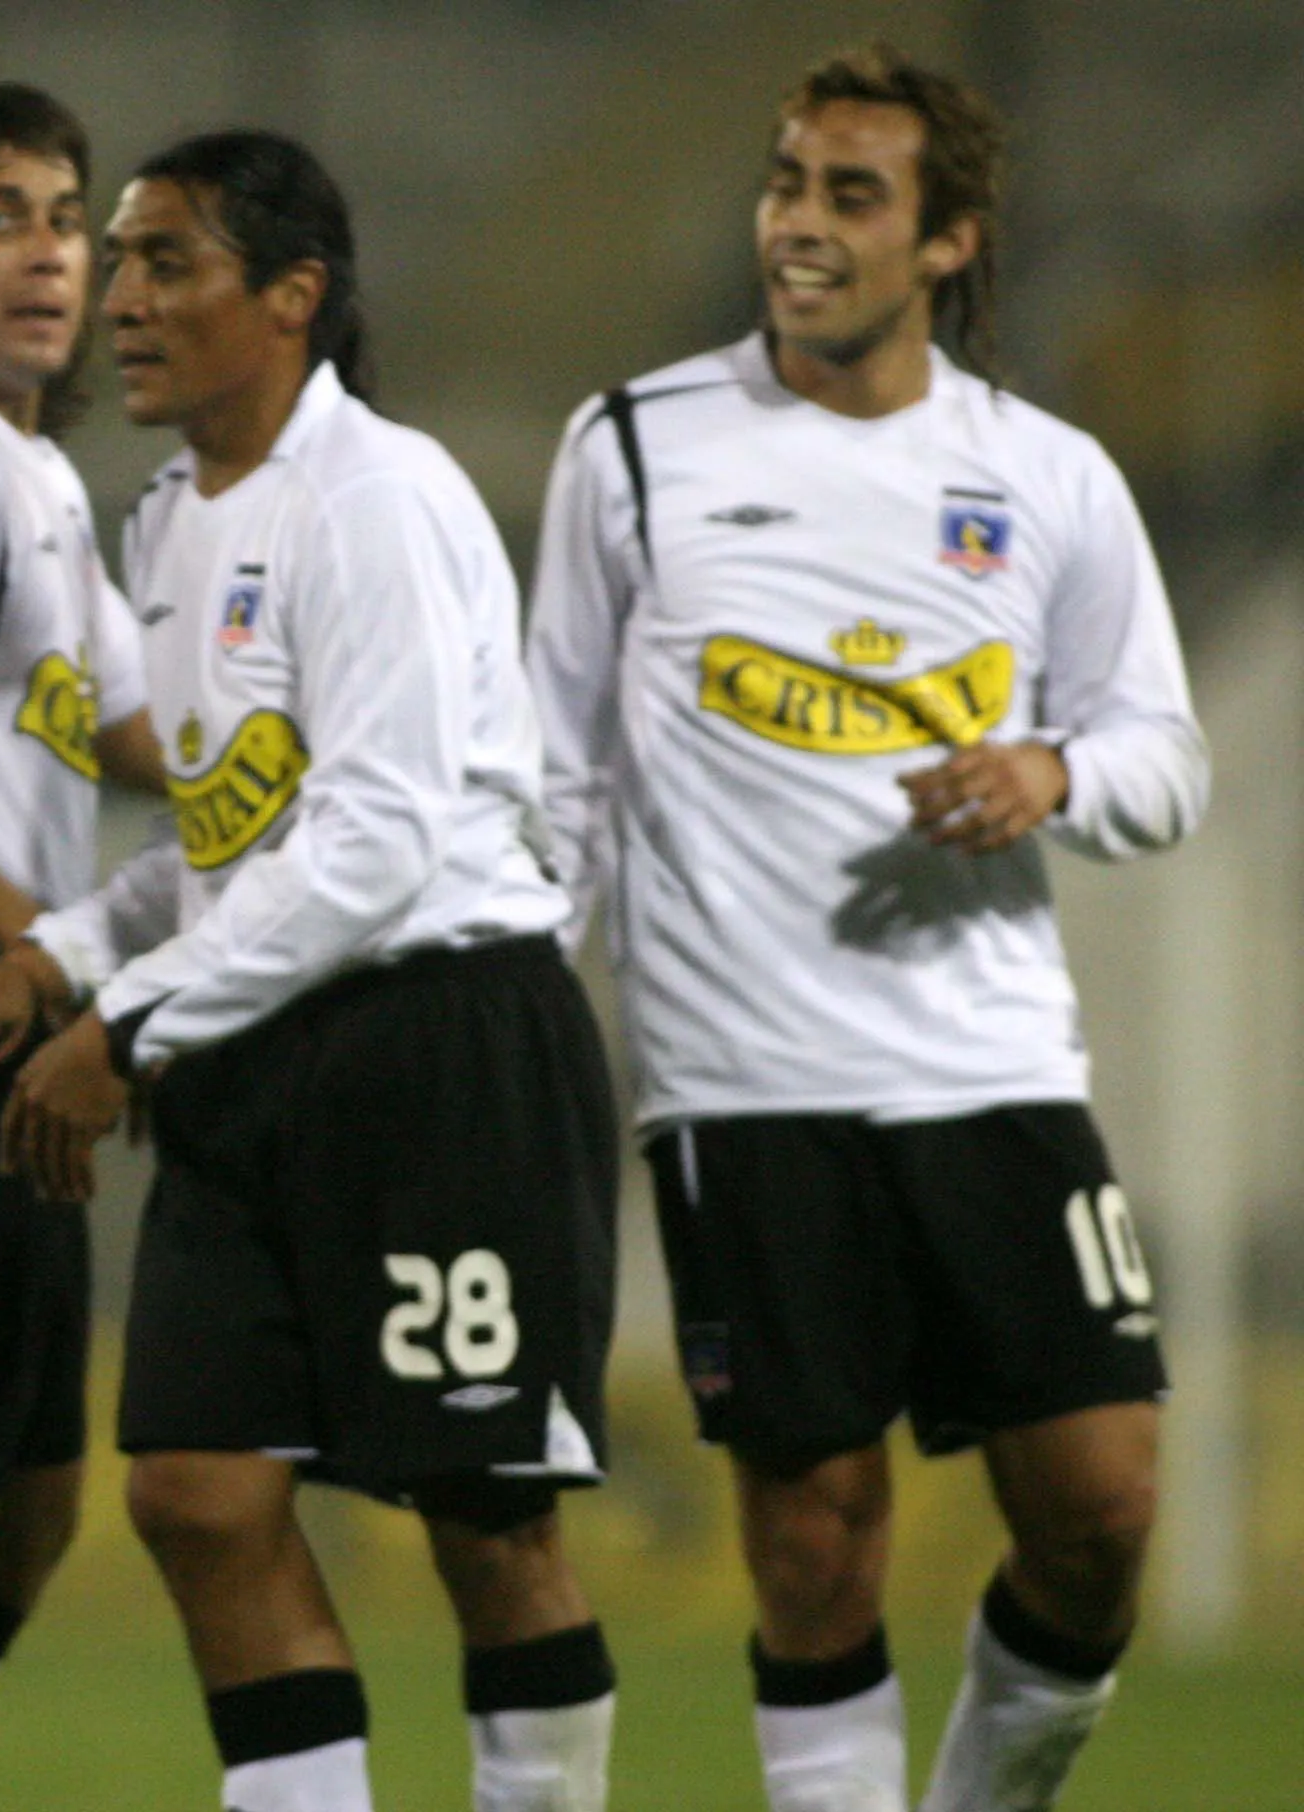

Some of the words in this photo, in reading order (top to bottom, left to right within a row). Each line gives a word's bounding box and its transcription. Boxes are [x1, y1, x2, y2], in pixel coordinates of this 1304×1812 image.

[717, 658, 1003, 737] CRISL
[1065, 1183, 1153, 1310] 10
[380, 1248, 520, 1380] 28
